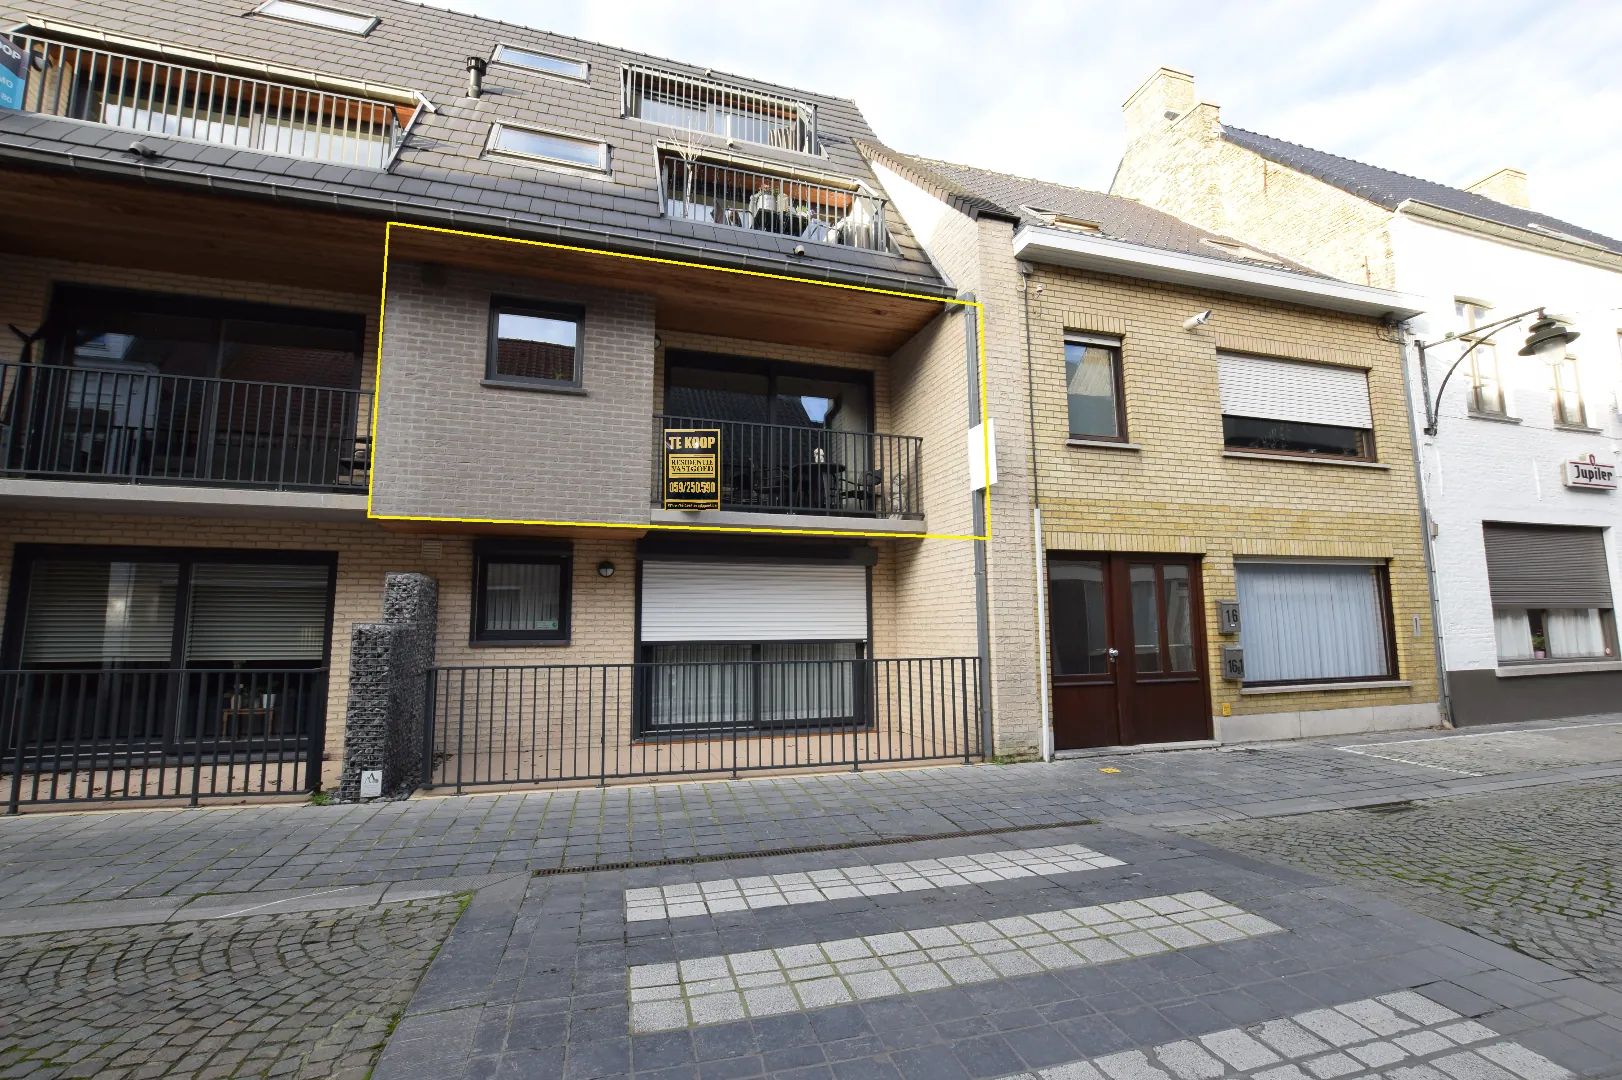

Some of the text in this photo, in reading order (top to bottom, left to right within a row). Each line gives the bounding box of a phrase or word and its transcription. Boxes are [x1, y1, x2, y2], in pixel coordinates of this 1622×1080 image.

[0, 41, 21, 60] OP
[668, 436, 716, 449] TE KOOP
[1573, 464, 1613, 482] Jupiler
[669, 481, 716, 493] 059/250.590
[1226, 609, 1238, 623] 16
